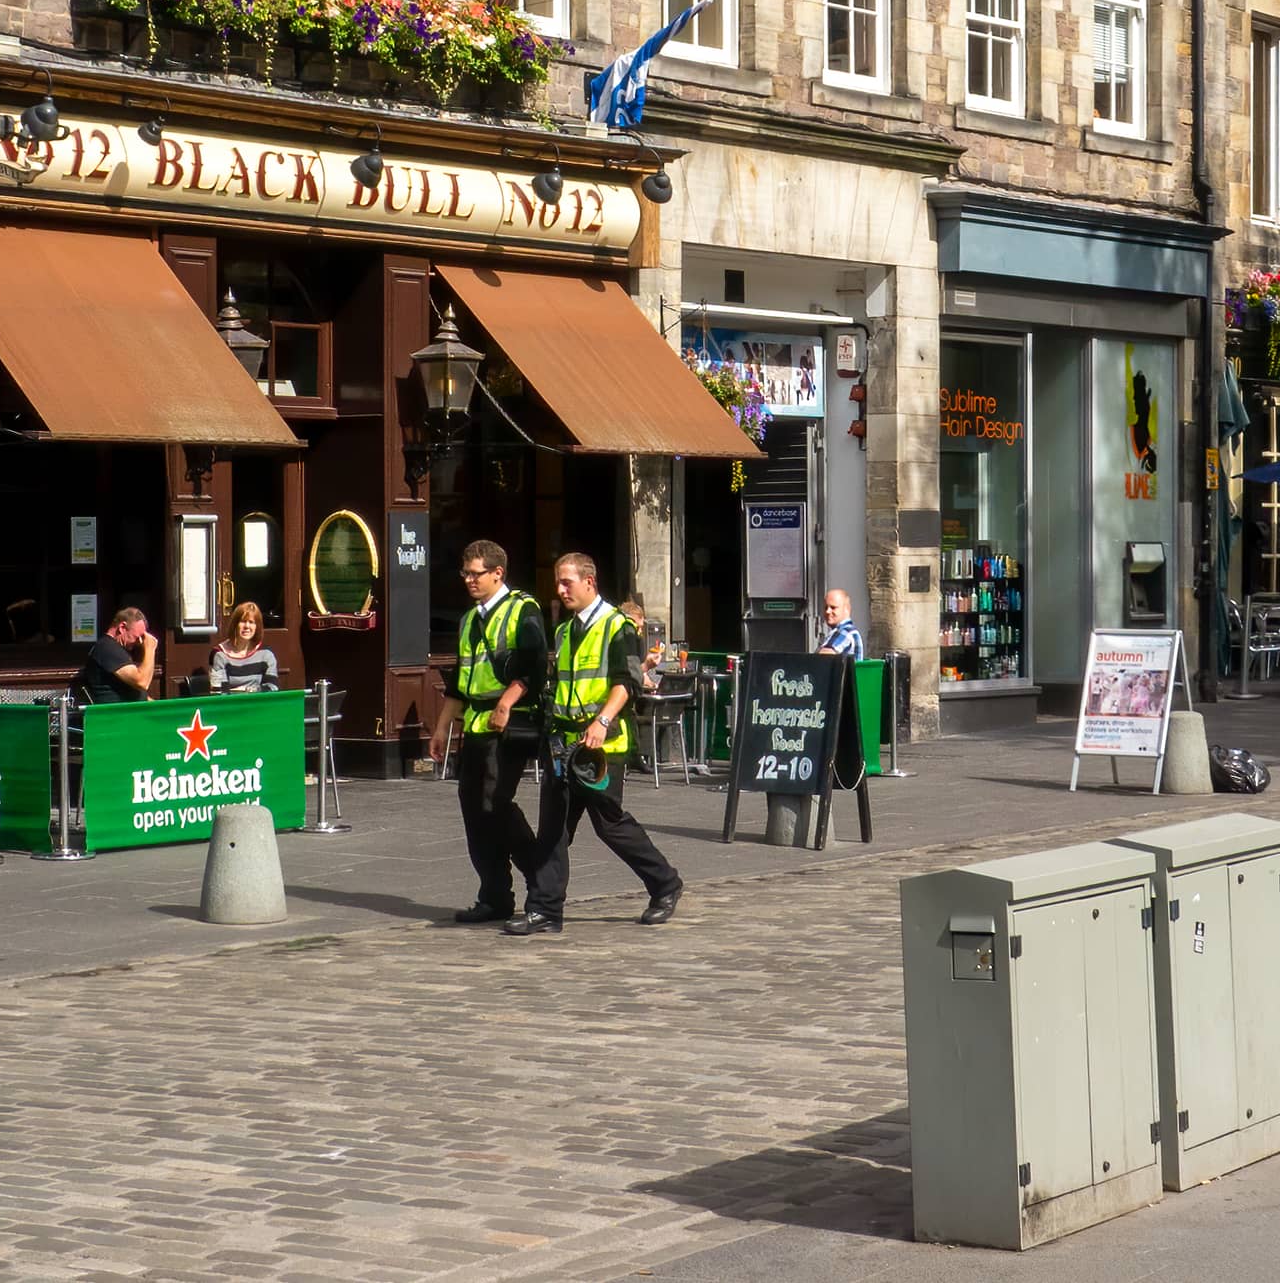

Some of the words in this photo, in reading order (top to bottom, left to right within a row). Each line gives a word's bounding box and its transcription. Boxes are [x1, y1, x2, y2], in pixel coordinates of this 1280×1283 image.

[62, 128, 110, 181] 12
[148, 138, 319, 204] BLACK
[346, 165, 476, 220] BULL
[565, 189, 604, 232] 12
[940, 388, 997, 414] Sublime
[976, 416, 1024, 446] Design
[1095, 650, 1144, 662] autumn
[771, 668, 814, 697] fresh
[751, 698, 826, 728] homemade
[771, 727, 807, 751] food
[756, 755, 813, 780] 12-10
[132, 762, 262, 804] Heineken
[133, 809, 176, 832] open
[179, 805, 214, 828] your
